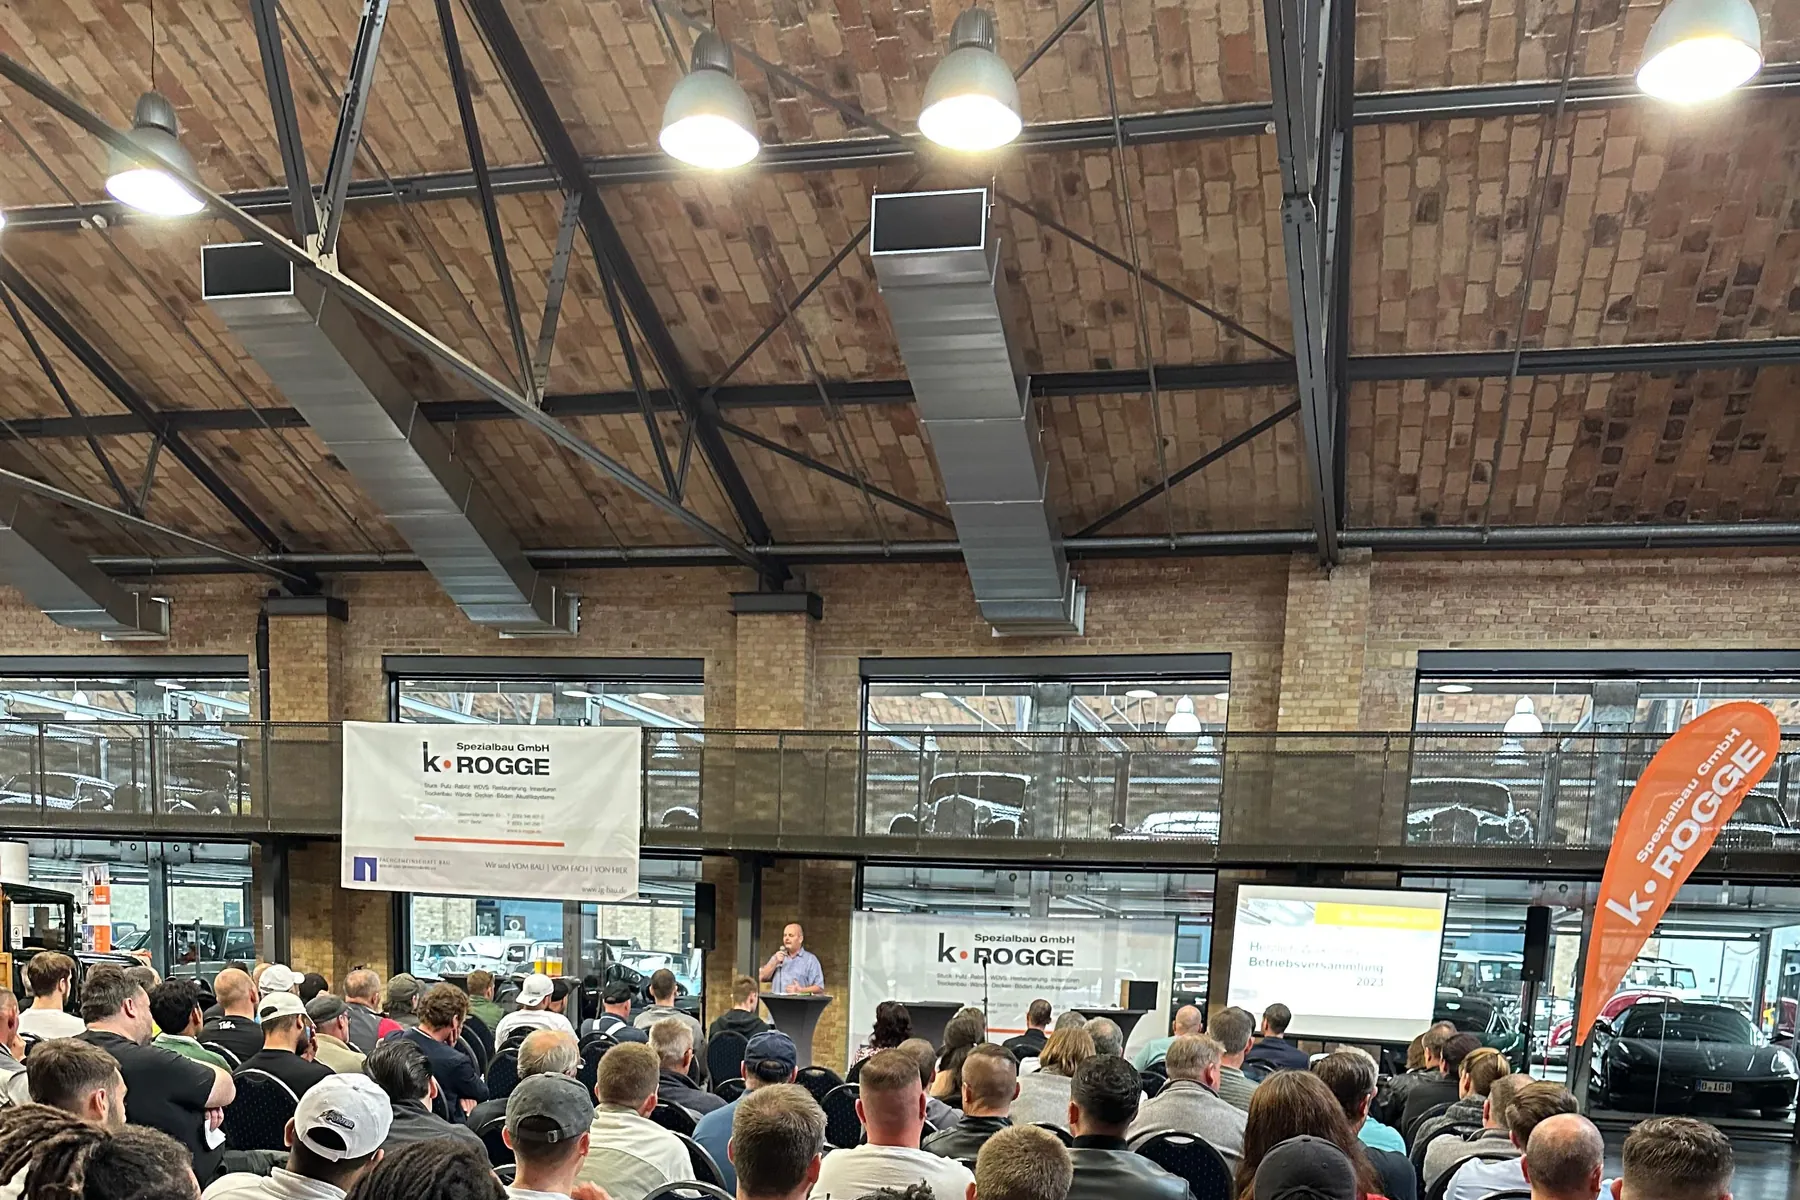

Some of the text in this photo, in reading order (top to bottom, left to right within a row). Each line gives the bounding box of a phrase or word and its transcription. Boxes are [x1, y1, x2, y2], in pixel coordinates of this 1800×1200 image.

[422, 741, 550, 776] k ROGGE
[456, 742, 550, 752] Spezialbau GmbH
[1636, 727, 1741, 864] Spezialbau GmbH
[1650, 738, 1767, 881] ROGGE
[485, 861, 496, 869] Wir
[512, 862, 529, 870] VOM
[530, 863, 545, 871] BAU
[552, 864, 569, 872] VOM
[571, 865, 588, 873] FACH
[937, 932, 1075, 967] k ROGGE
[974, 933, 1075, 944] Spezialbau GmbH
[1248, 956, 1384, 974] Betriebsversammlung
